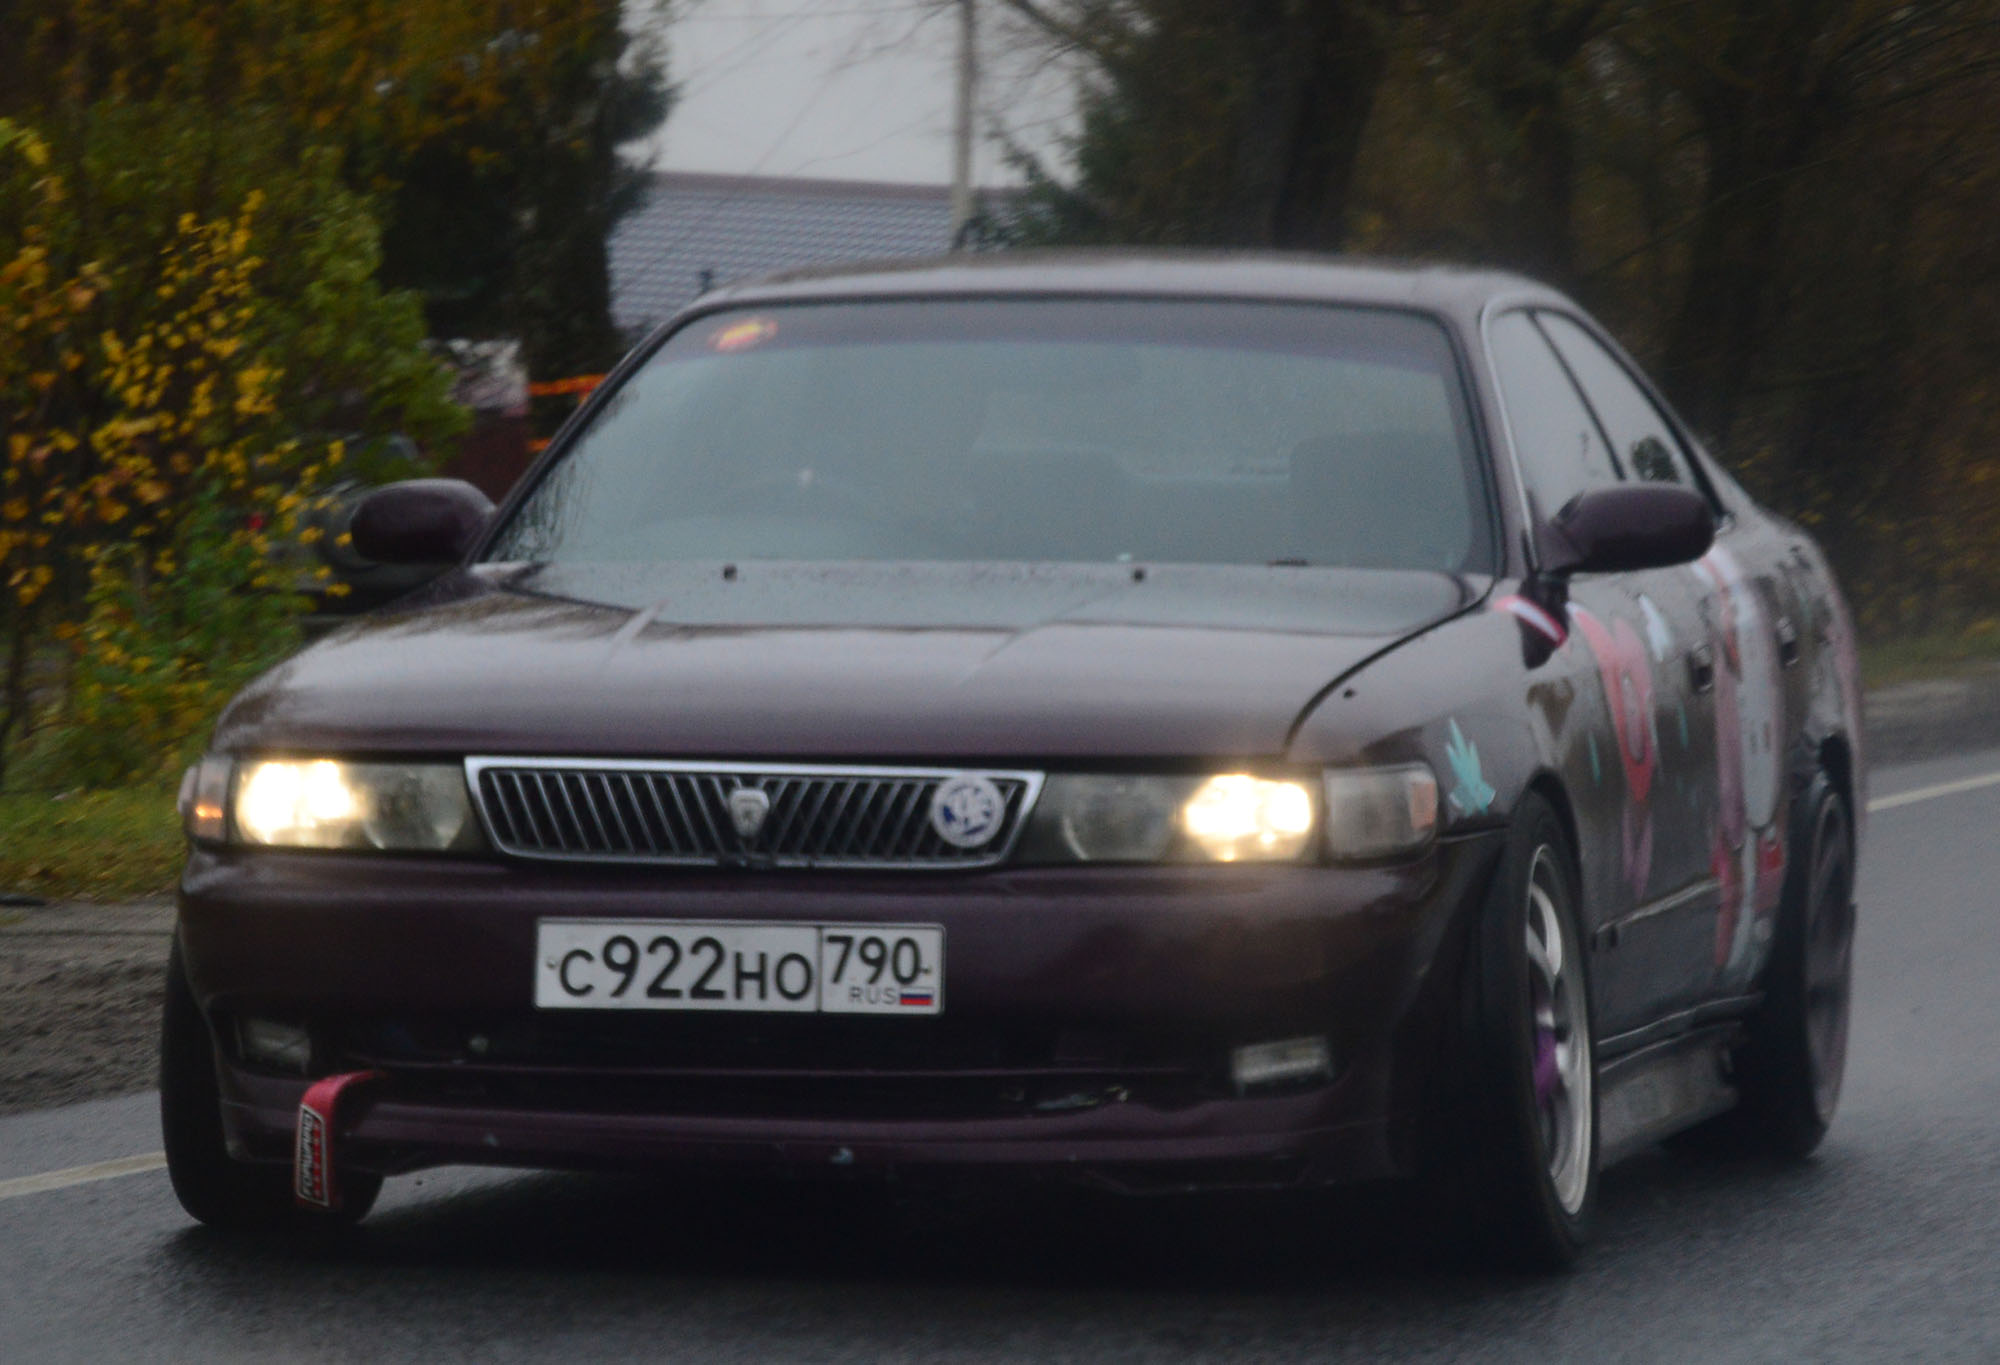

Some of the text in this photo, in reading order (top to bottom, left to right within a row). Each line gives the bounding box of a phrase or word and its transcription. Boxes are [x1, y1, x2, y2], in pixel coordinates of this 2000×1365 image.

[559, 934, 922, 1001] C922HO 790
[849, 985, 897, 1005] RUS
